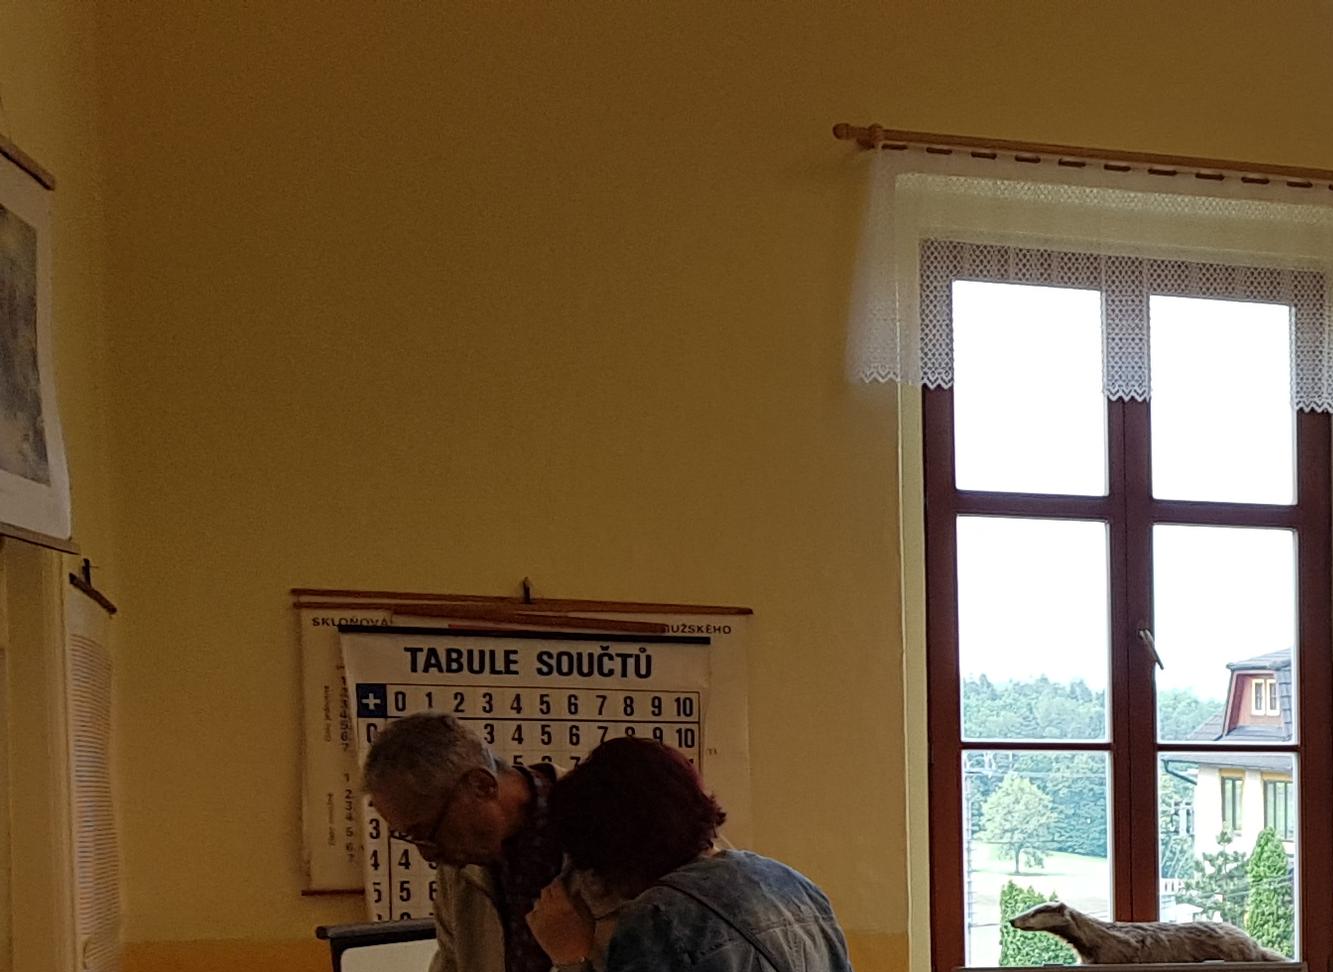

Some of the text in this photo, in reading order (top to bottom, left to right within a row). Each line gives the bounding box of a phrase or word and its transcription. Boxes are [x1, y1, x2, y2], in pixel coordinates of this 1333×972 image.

[404, 645, 652, 680] TABULE SOUČTŮ
[395, 691, 406, 712] 0
[453, 691, 465, 713] 2
[482, 692, 493, 713] 3
[510, 693, 523, 714] 4
[539, 694, 551, 715] 5
[567, 694, 579, 715] 6
[596, 695, 607, 716] 7
[624, 696, 635, 717] 8
[651, 696, 662, 717] 9
[674, 697, 694, 717] 10
[484, 723, 495, 744] 3
[512, 724, 524, 745] 4
[541, 724, 552, 746] 5
[569, 725, 580, 746] 6
[676, 728, 696, 748] 10
[369, 818, 380, 840] 3
[398, 849, 411, 870] 4
[399, 881, 411, 902] 5
